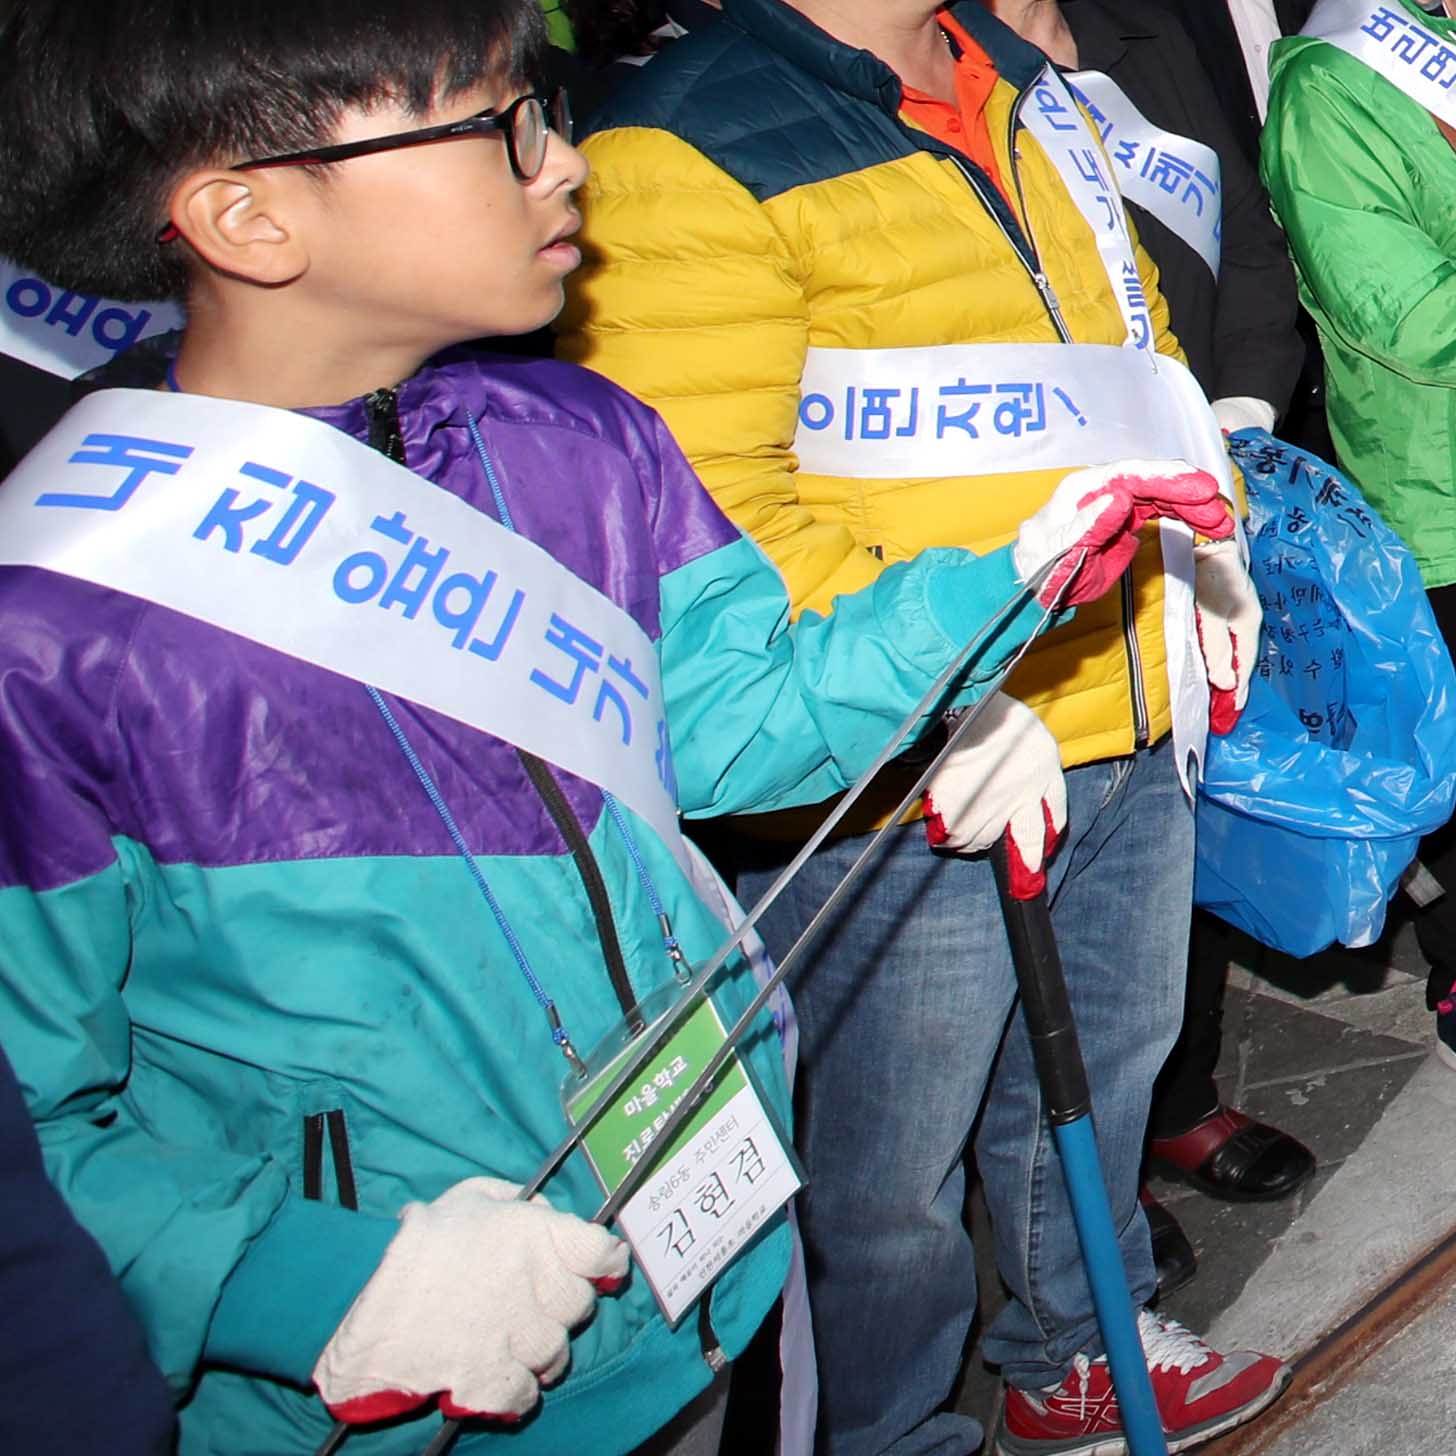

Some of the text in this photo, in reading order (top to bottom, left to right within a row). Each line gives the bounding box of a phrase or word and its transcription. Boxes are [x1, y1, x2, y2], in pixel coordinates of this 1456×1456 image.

[936, 376, 1089, 440] 자원!
[34, 432, 651, 748] 내 집 앞은 내가
[623, 1056, 688, 1118] 마을학교
[693, 1115, 741, 1164] 주민센터
[656, 1137, 768, 1258] 김현겸
